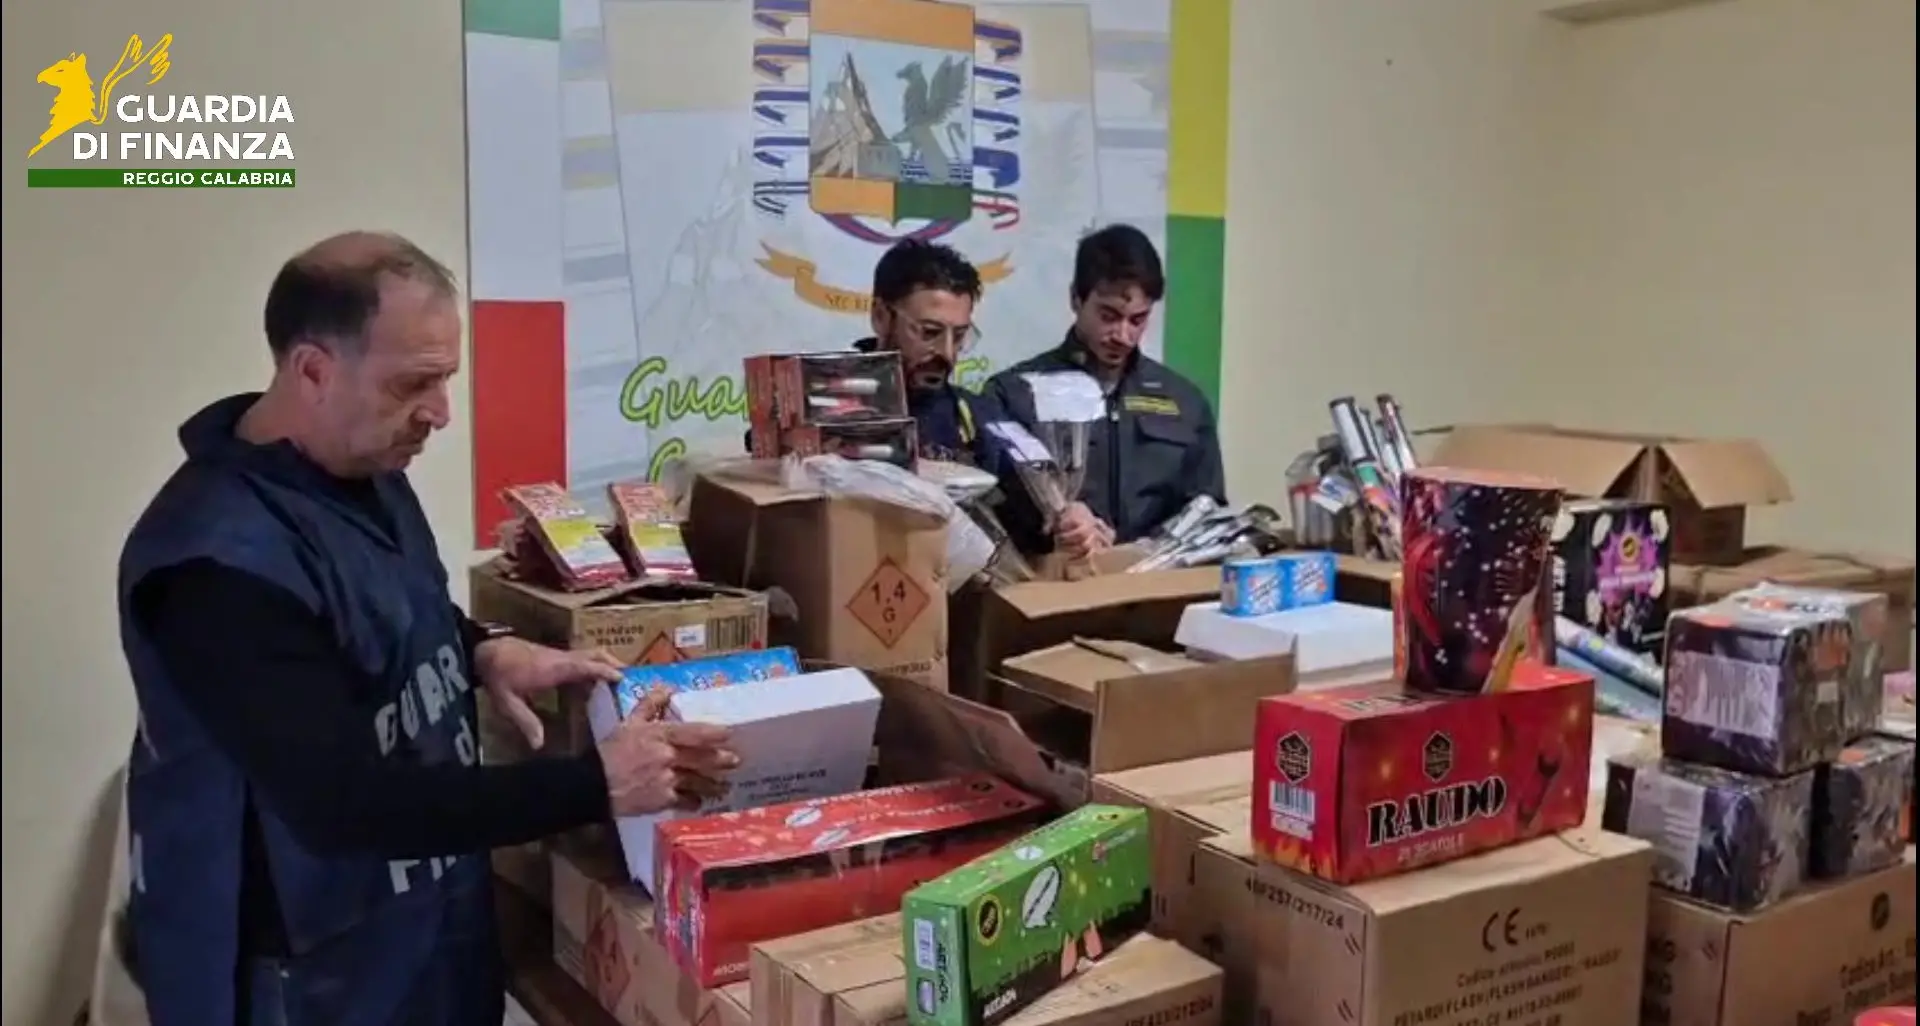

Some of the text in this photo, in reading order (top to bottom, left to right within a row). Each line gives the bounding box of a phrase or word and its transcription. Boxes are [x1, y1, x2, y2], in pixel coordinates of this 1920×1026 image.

[870, 579, 907, 606] 1.4
[882, 606, 896, 624] G
[1365, 775, 1508, 848] RAUDO
